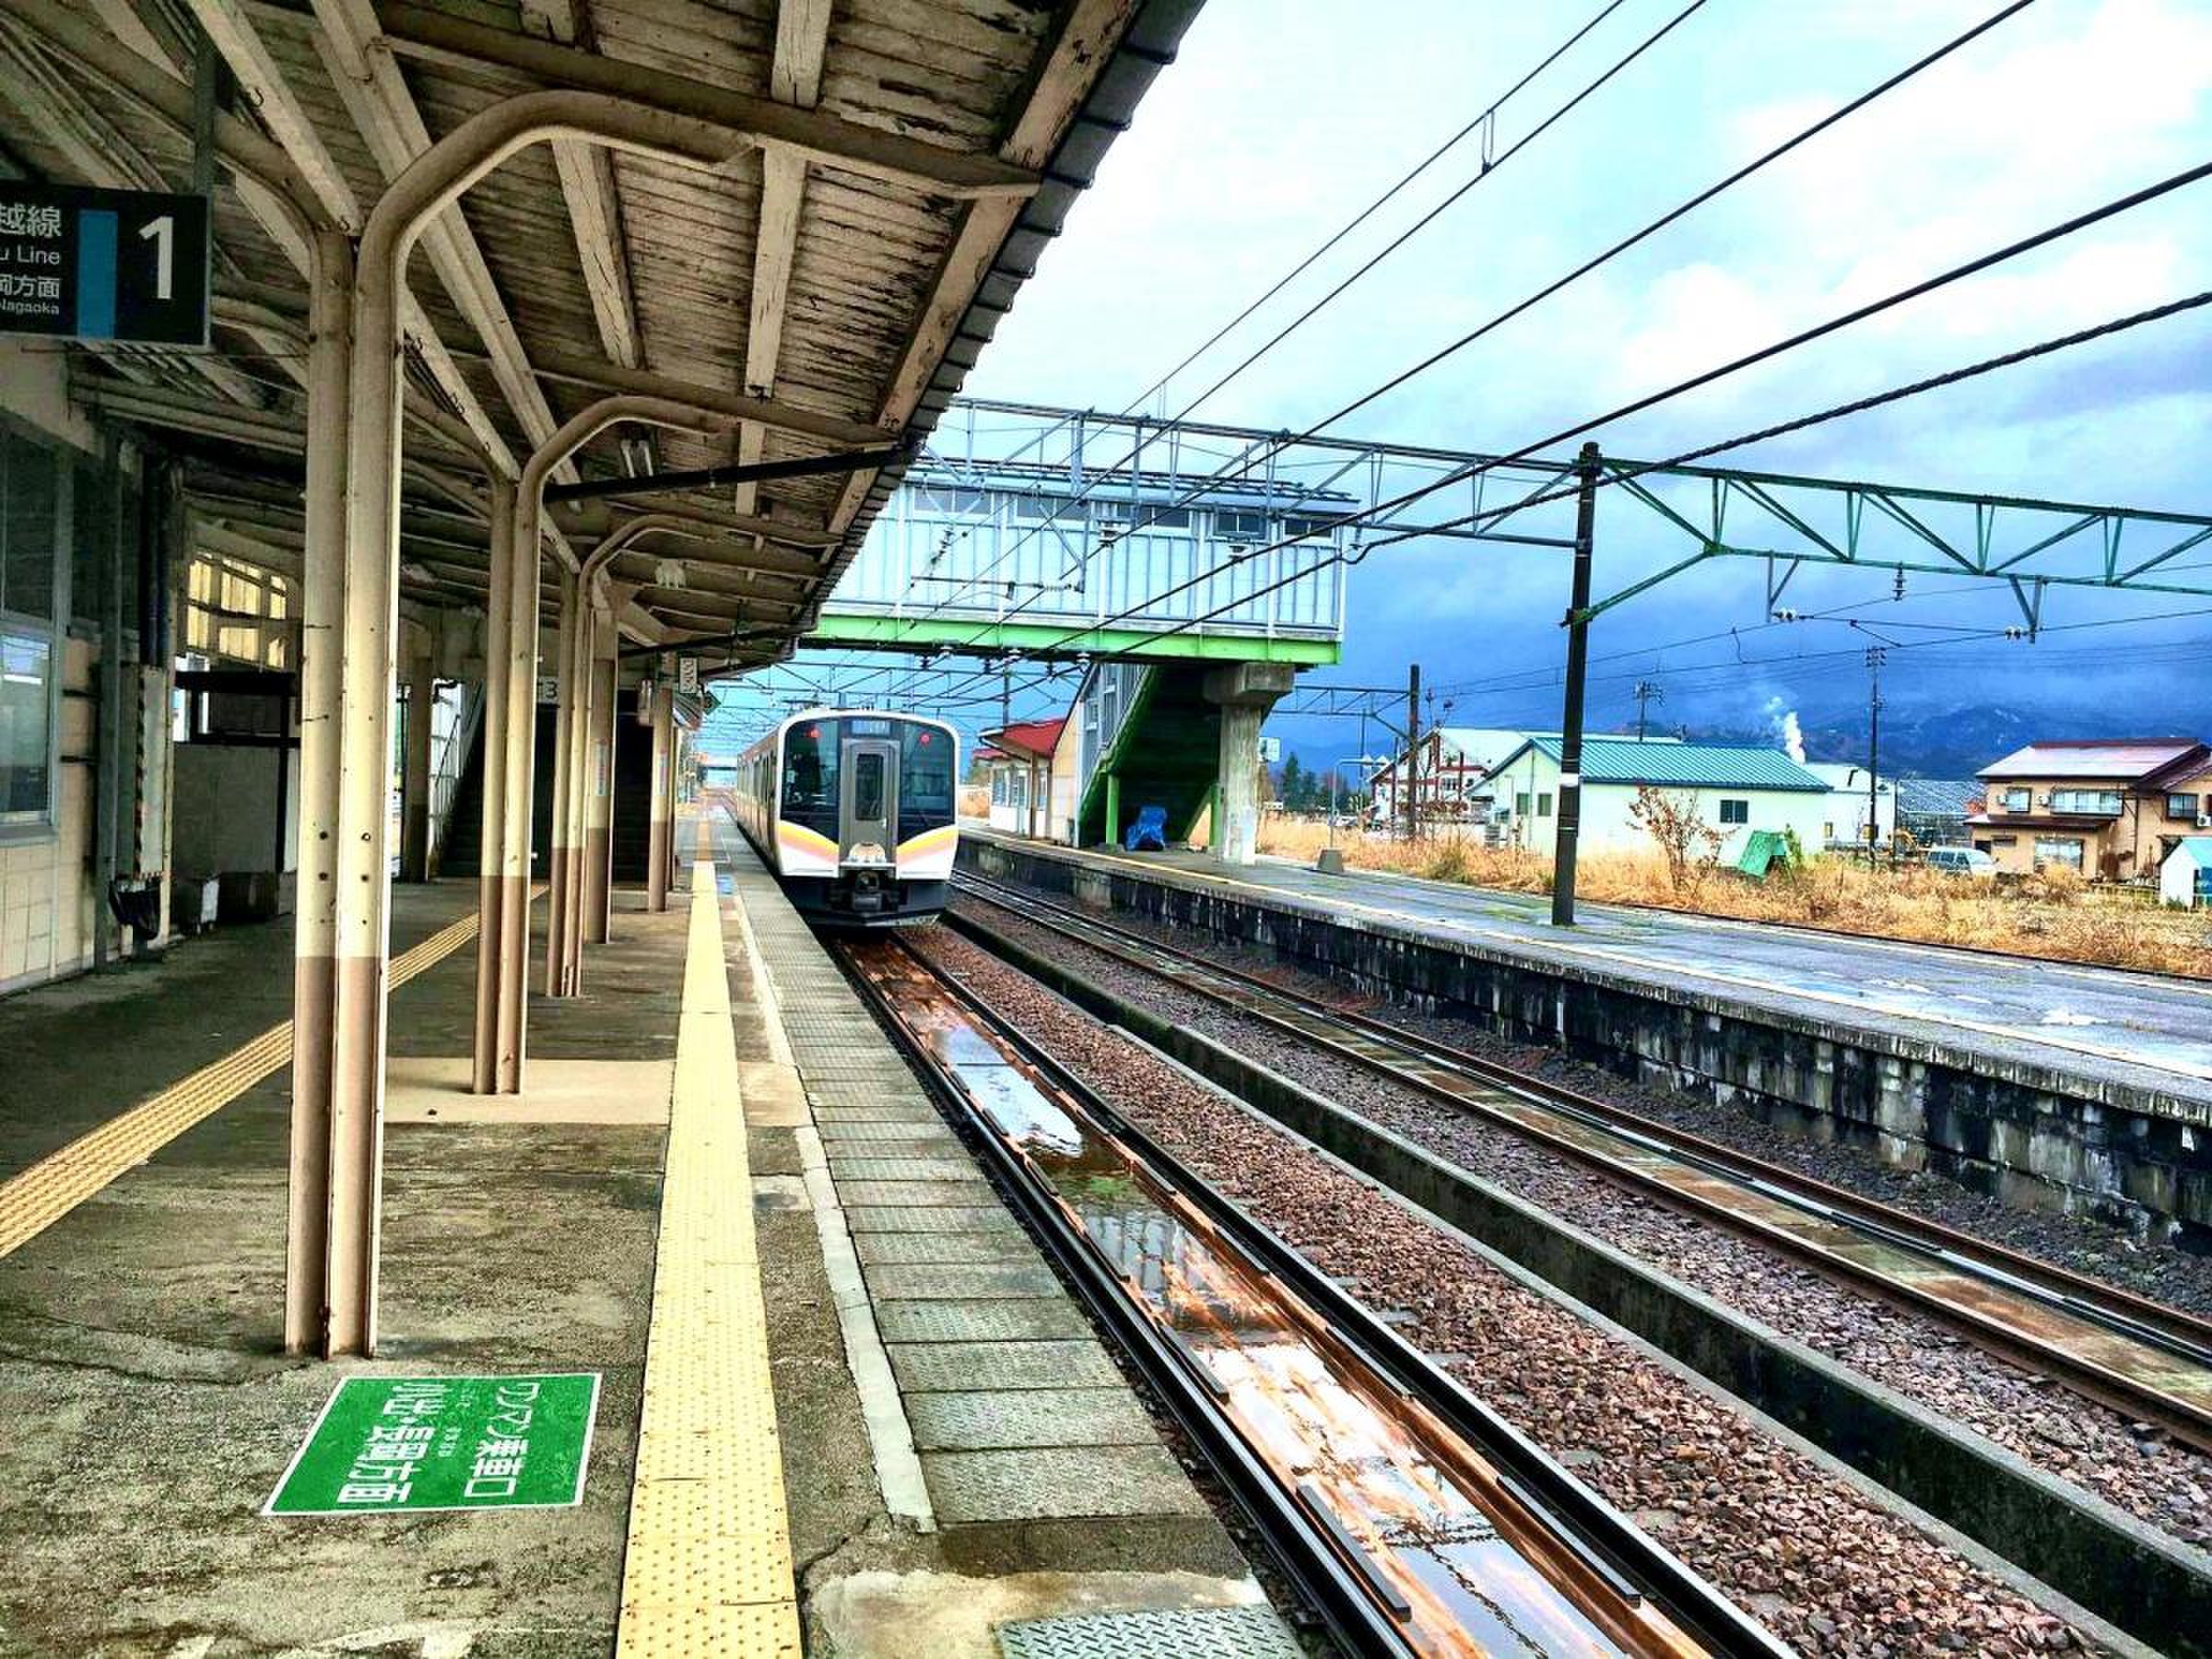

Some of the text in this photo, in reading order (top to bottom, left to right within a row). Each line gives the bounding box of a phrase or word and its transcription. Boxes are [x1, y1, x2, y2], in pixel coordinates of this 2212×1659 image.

[17, 244, 60, 265] Line
[138, 216, 173, 300] 1
[336, 1382, 454, 1503] 小出・長岡方面
[464, 1382, 541, 1499] ワンマン乗車口
